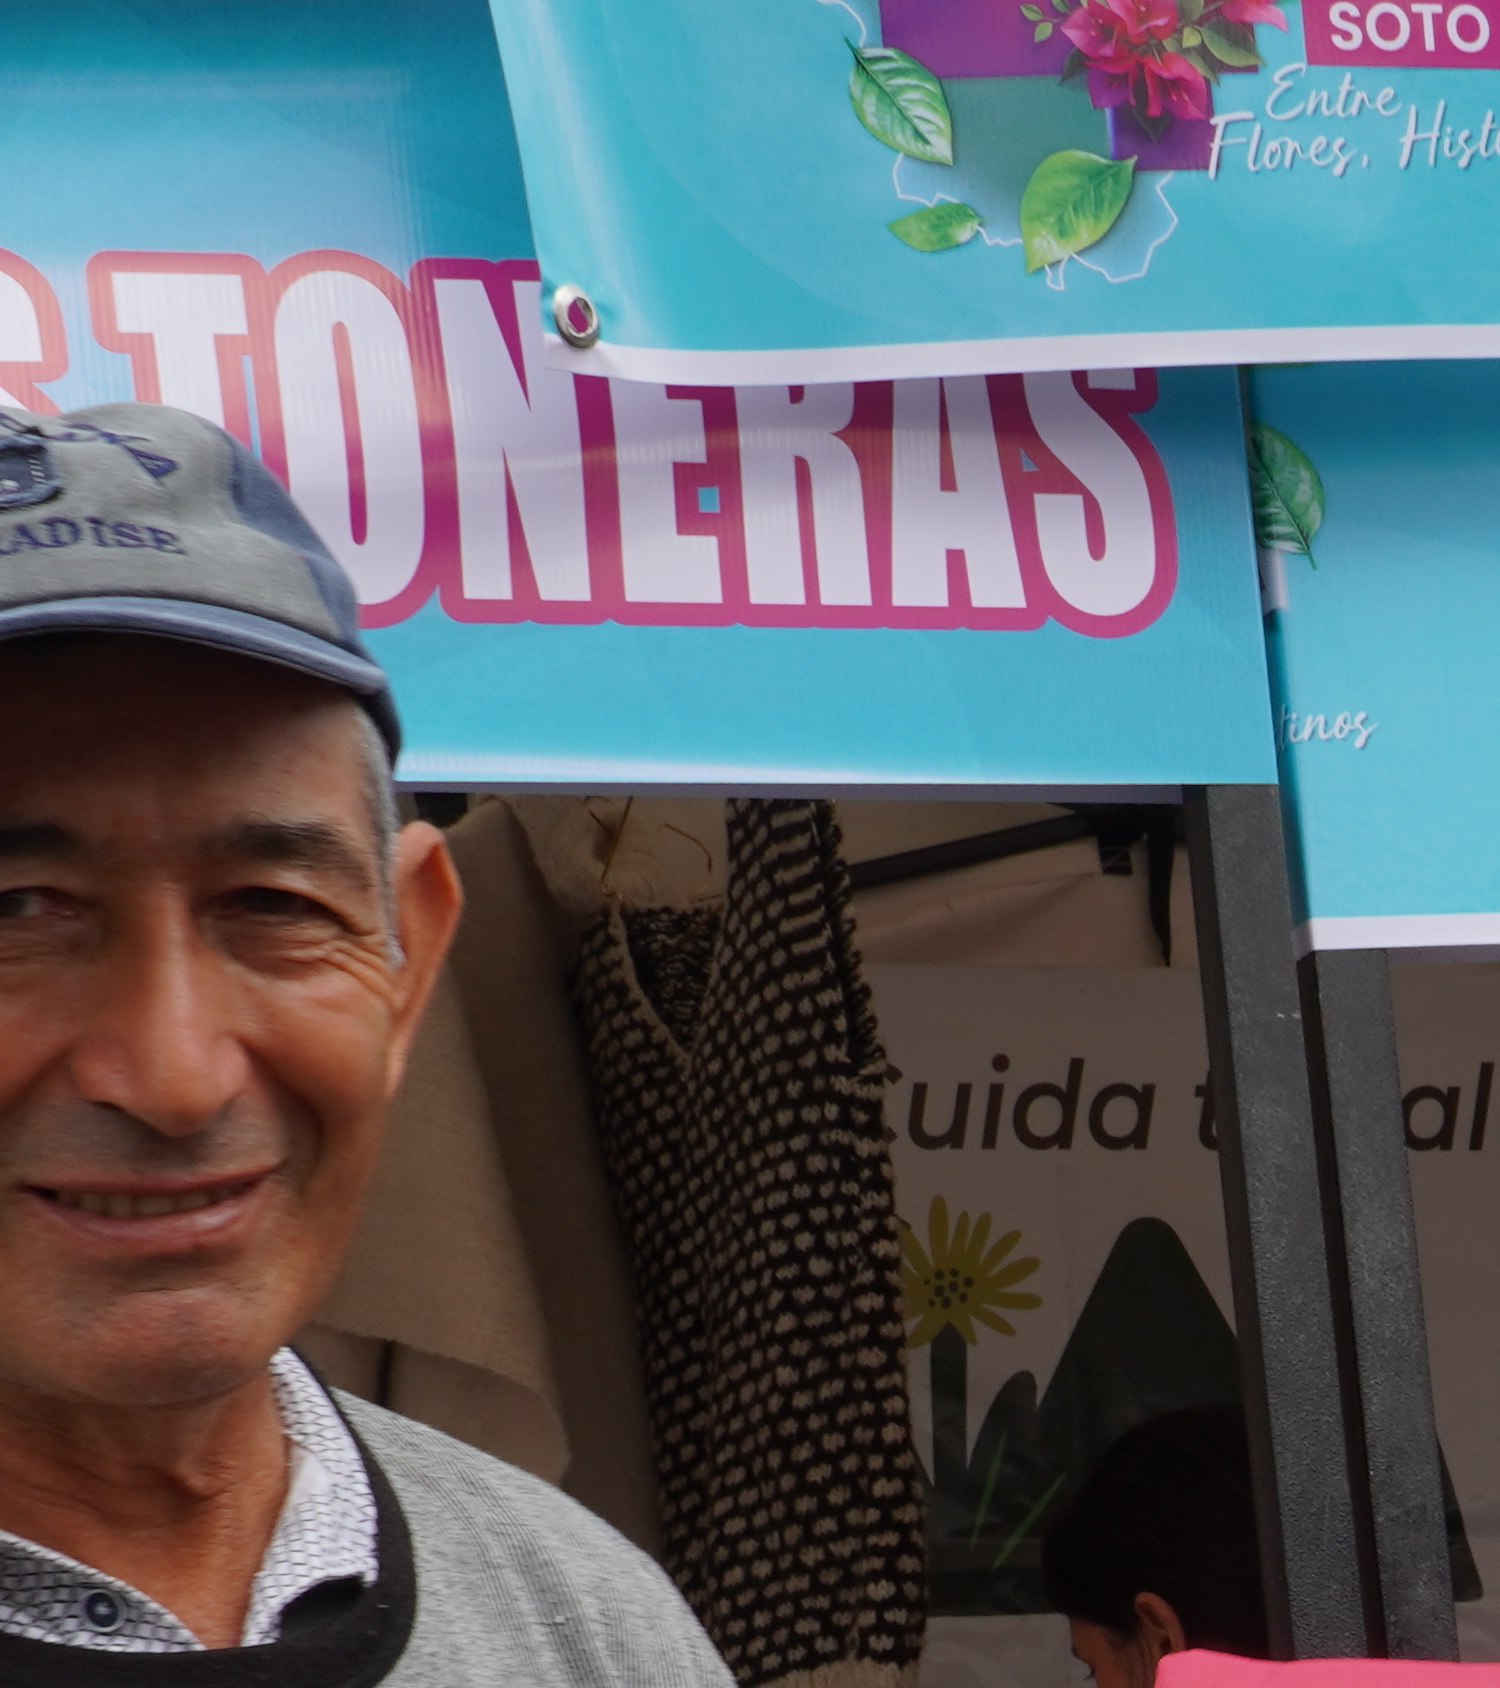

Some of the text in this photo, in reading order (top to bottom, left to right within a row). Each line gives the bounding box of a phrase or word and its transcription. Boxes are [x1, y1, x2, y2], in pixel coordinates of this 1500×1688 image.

[1328, 1, 1492, 53] SOTO
[1265, 63, 1401, 122] Entre
[1206, 111, 1372, 181] Flores,
[110, 265, 1160, 618] TONERAS
[886, 1054, 1157, 1152] uida
